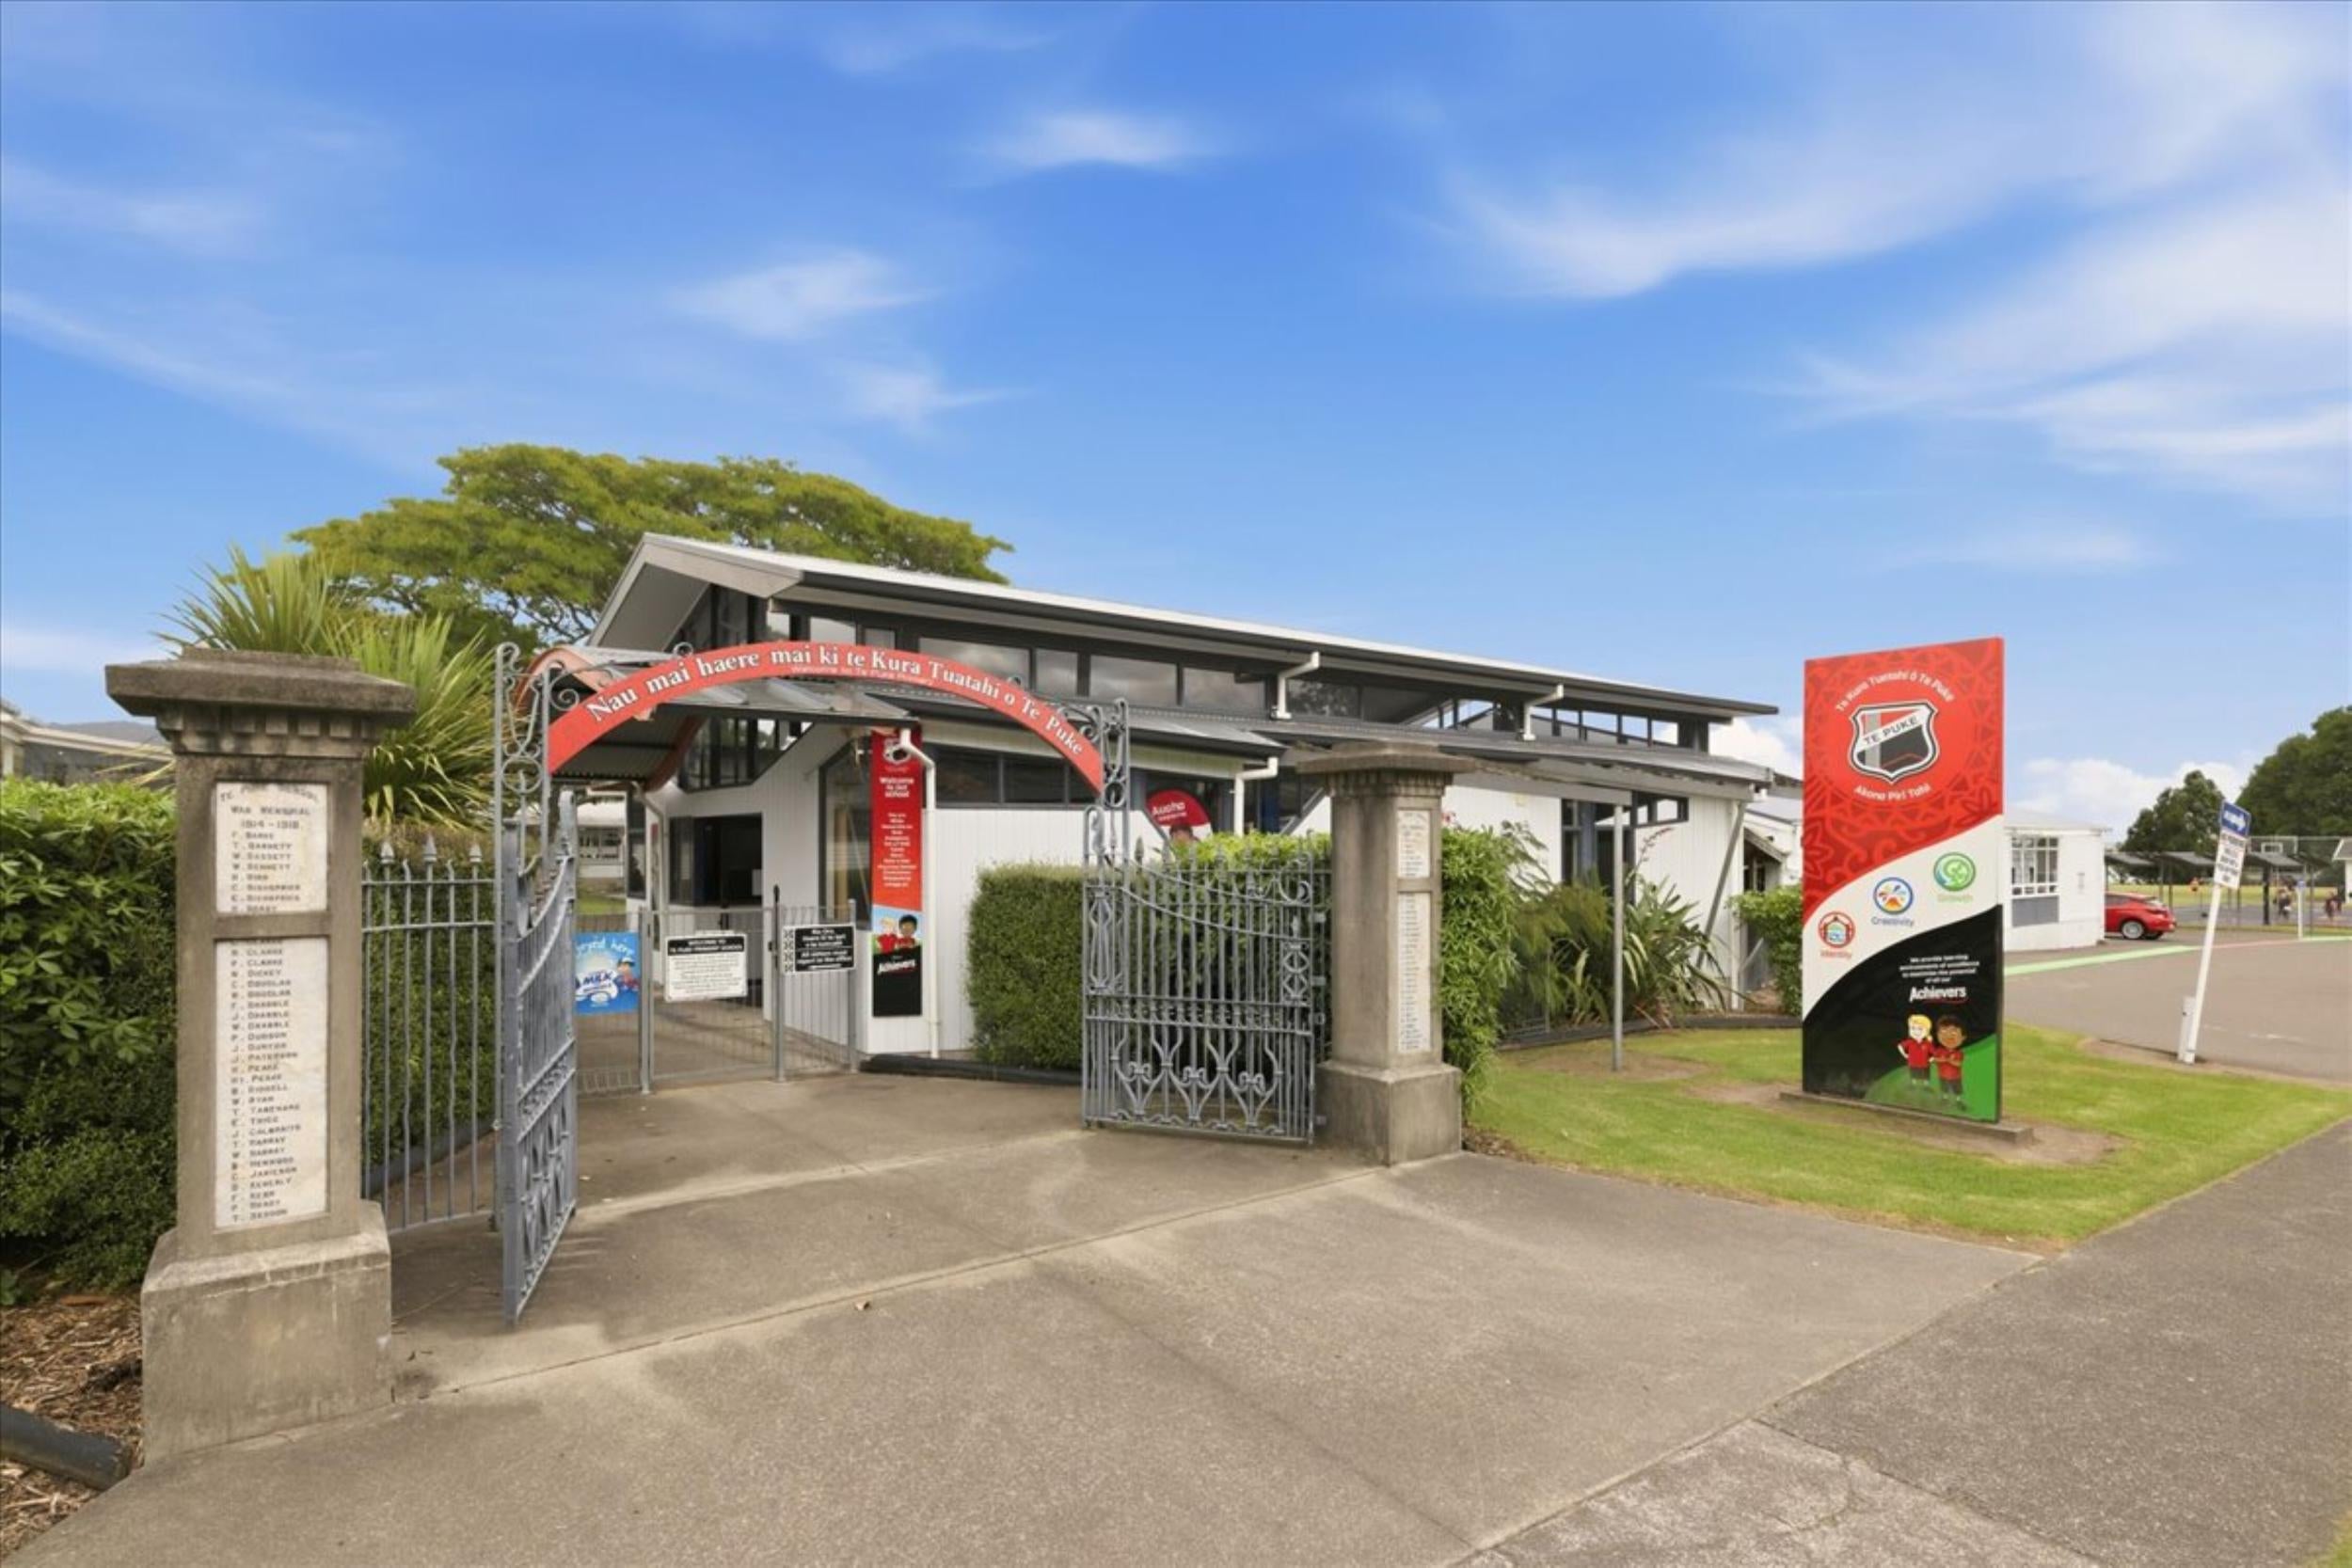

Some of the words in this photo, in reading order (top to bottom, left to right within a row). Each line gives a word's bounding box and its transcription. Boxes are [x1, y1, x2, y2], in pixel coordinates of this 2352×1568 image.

[1836, 700, 1849, 712] Te
[1848, 681, 1869, 702] Kura
[1869, 671, 1909, 687] Tuatahi
[1919, 673, 1931, 685] Te
[1931, 677, 1955, 703] Puke
[585, 686, 639, 721] Nau
[645, 662, 691, 694] mai
[696, 652, 760, 677] haere
[771, 645, 811, 665] mai
[819, 645, 839, 665] ki
[847, 652, 866, 667] te
[871, 650, 921, 675] Kura
[929, 660, 998, 699] Tuatahi
[1004, 692, 1014, 705] o
[1022, 696, 1040, 720] Te
[1046, 714, 1082, 755] Puke
[1864, 734, 1880, 744] TE
[1882, 716, 1918, 737] PUKE
[880, 777, 914, 785] Welcome
[230, 806, 251, 815] WAR
[1871, 916, 1915, 927] Creativity
[582, 970, 613, 985] MILK
[1909, 986, 1967, 1004] Achievers
